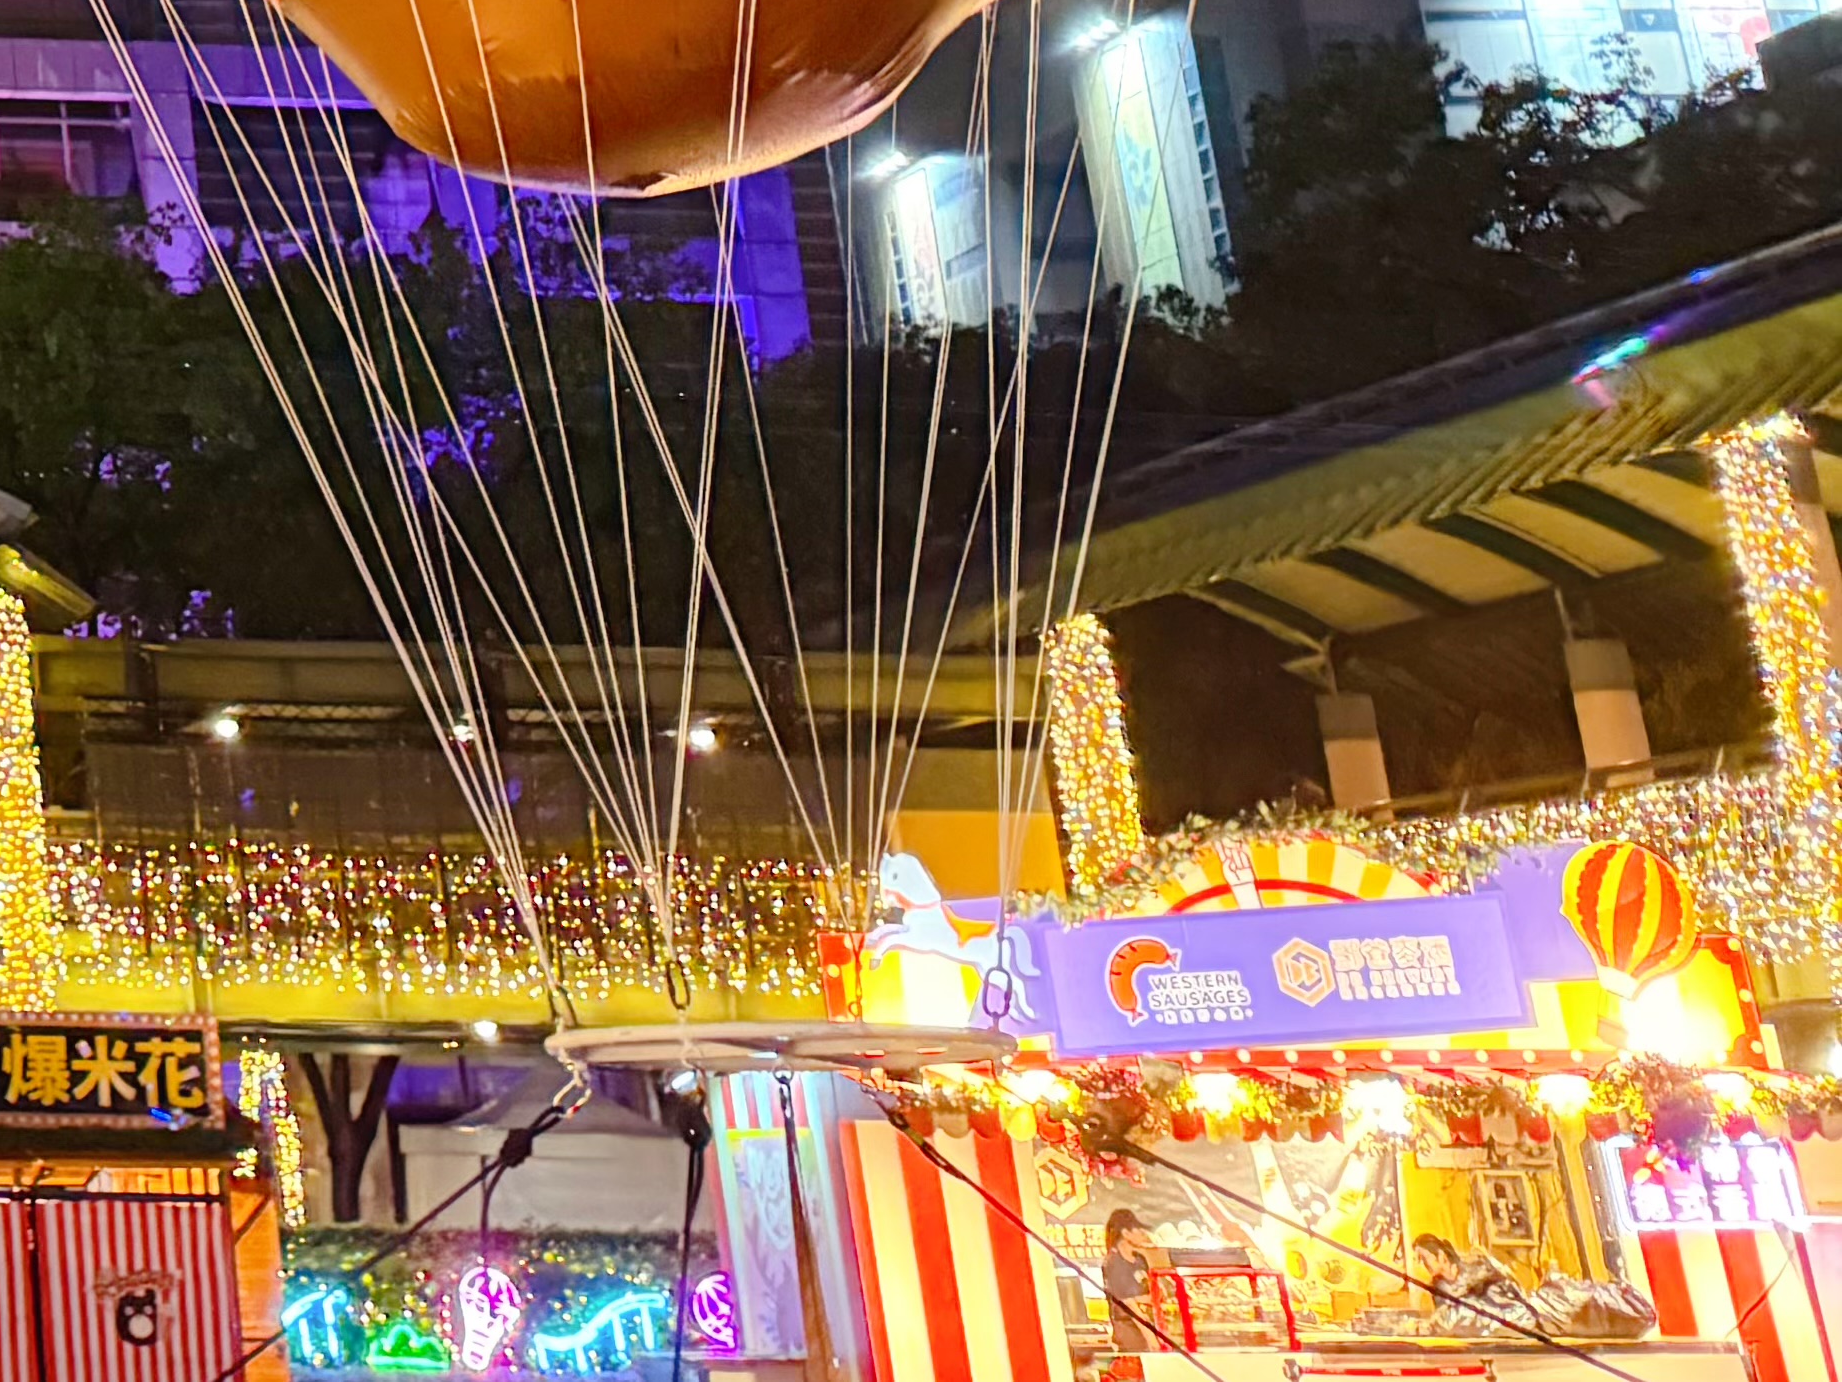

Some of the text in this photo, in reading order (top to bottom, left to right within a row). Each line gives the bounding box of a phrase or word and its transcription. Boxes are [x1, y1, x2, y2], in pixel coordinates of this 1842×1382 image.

[1150, 972, 1240, 990] WESTERN
[1149, 989, 1250, 1008] SAUSAGES
[1, 1033, 205, 1109] 爆米花
